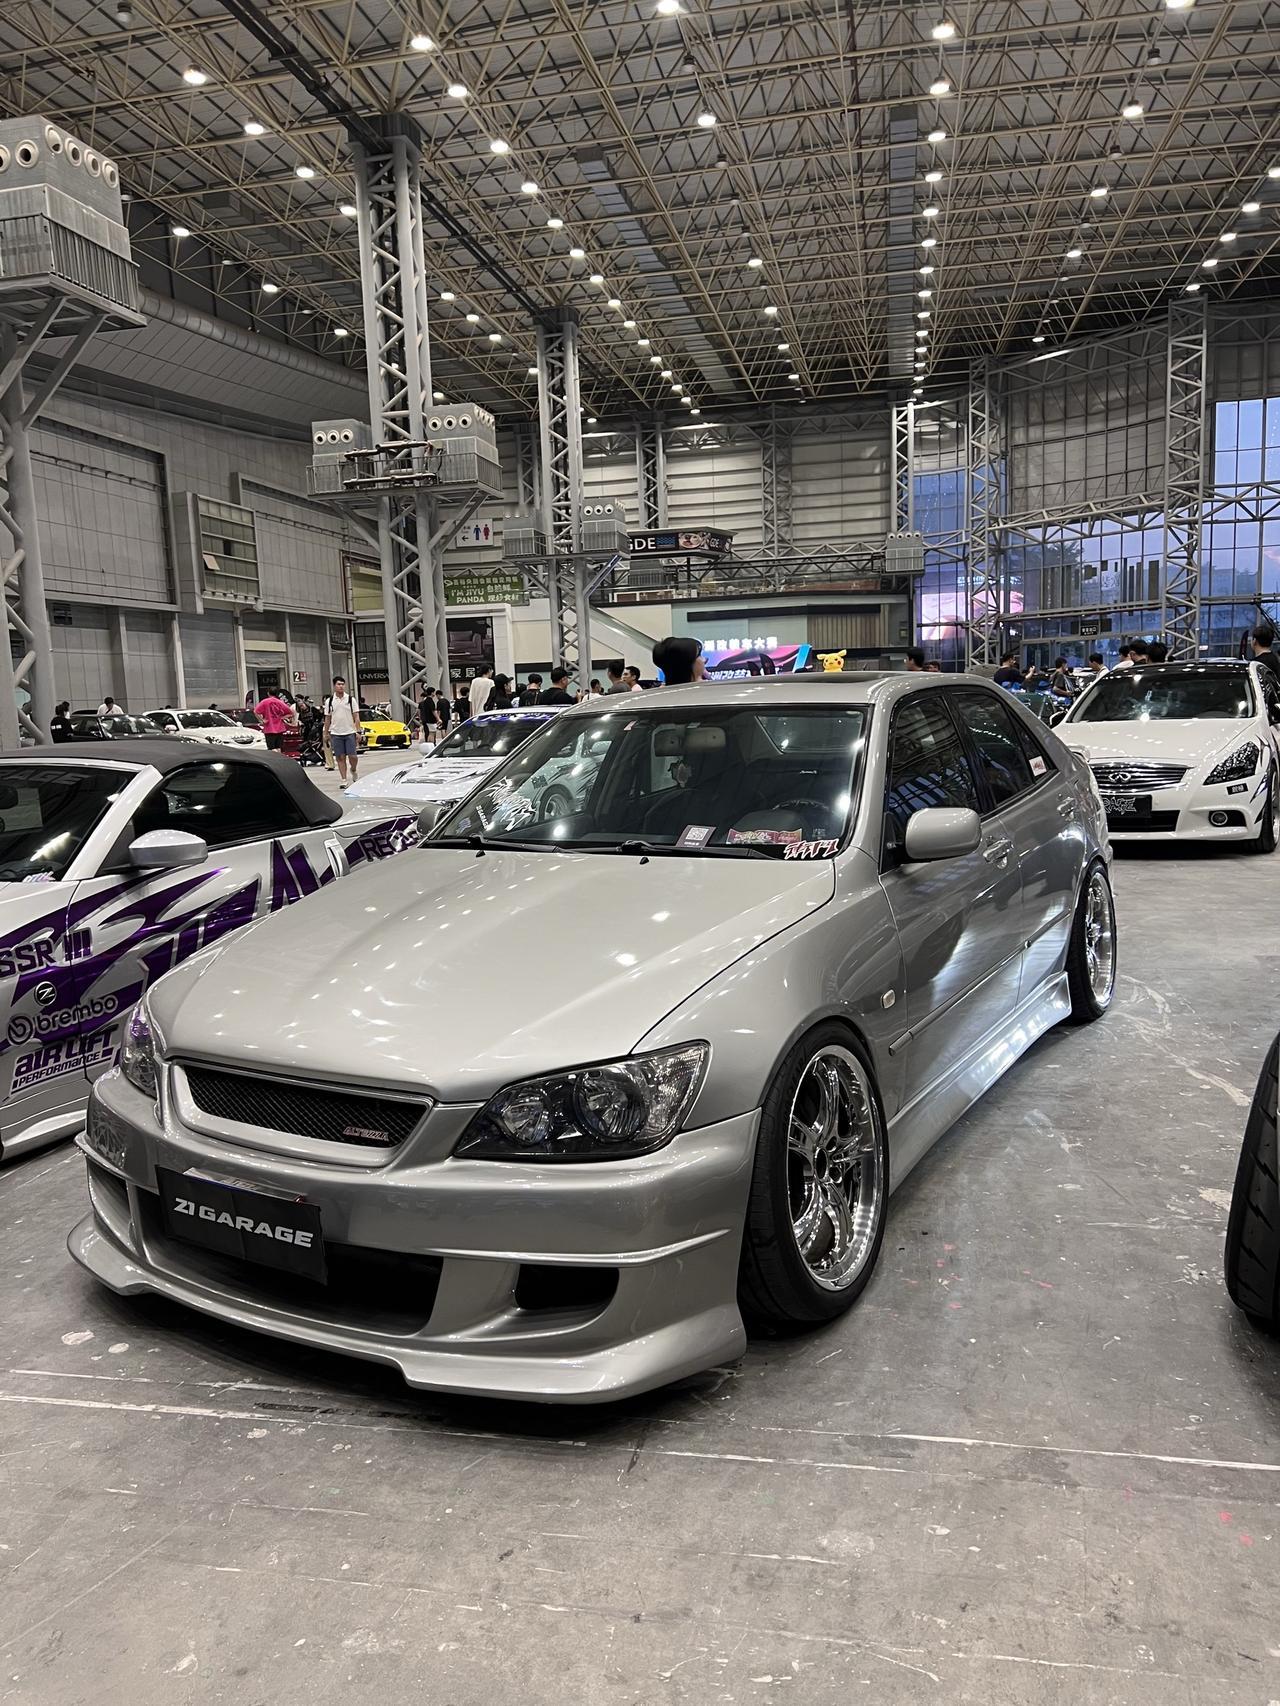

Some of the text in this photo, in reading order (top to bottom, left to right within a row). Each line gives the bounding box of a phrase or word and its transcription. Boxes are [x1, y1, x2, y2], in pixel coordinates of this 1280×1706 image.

[456, 596, 485, 604] PANDA
[294, 671, 300, 682] 2
[450, 667, 476, 678] 家居
[37, 996, 118, 1031] brembo
[198, 1205, 314, 1248] GARAGE
